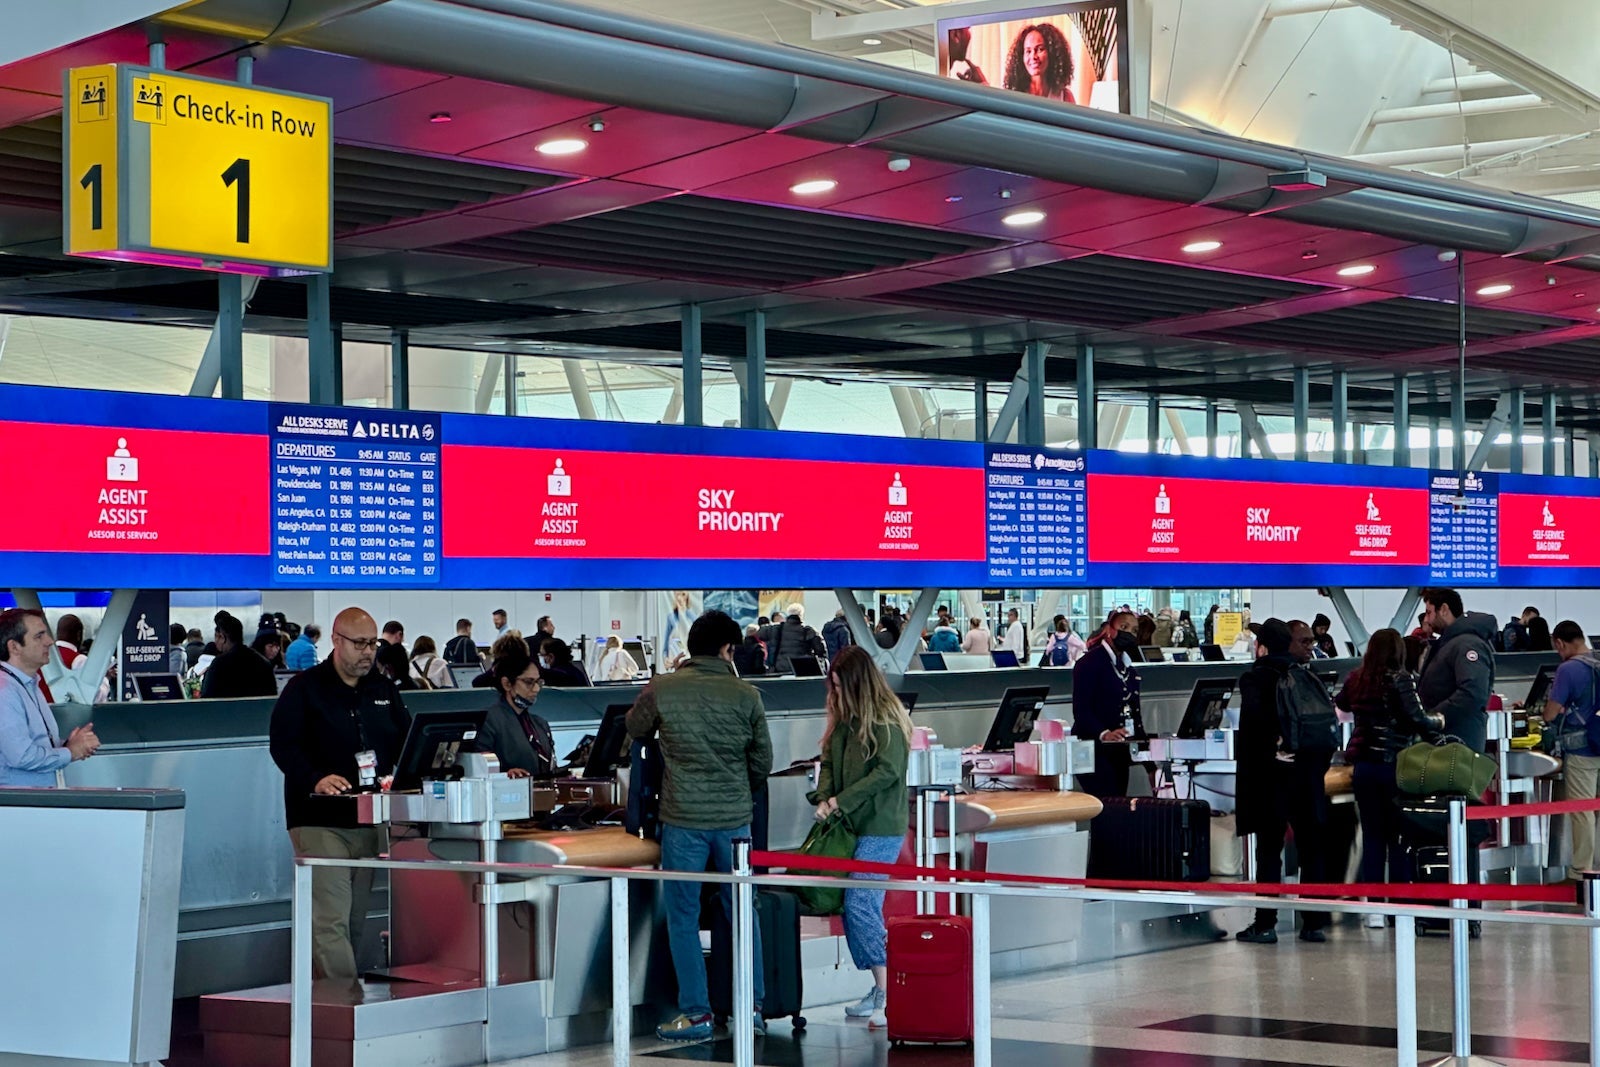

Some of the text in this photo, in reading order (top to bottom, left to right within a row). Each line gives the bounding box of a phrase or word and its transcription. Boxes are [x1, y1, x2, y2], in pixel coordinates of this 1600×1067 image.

[173, 94, 315, 138] Check-in Row
[80, 164, 102, 230] 1
[221, 158, 250, 244] 1
[283, 416, 348, 429] ALL DESKS SERVE
[369, 422, 419, 439] DELTA
[276, 443, 436, 462] DEPARTURES 9:45 AM STATUS GATE
[277, 464, 288, 473] Las
[289, 465, 309, 476] Vegas,
[310, 466, 321, 474] NV
[330, 466, 338, 475] DL
[374, 469, 384, 477] AM
[388, 469, 414, 479] On-Time
[277, 479, 321, 489] Providenciales
[330, 481, 339, 490] DL
[388, 483, 395, 492] At
[396, 483, 410, 492] Gate
[98, 488, 148, 505] AGENT
[278, 493, 290, 502] San
[291, 494, 306, 502] Juan
[330, 495, 339, 504] DL
[388, 497, 415, 506] On-Time
[698, 488, 735, 509] SKY
[278, 508, 289, 517] Los
[316, 509, 325, 517] CA
[330, 509, 339, 518] DL
[375, 510, 385, 519] PM
[388, 511, 397, 519] At
[398, 511, 411, 520] Gate
[541, 502, 578, 516] AGENT
[1247, 507, 1270, 524] SKY
[98, 508, 148, 525] ASSIST
[698, 511, 781, 531] PRIORITY
[884, 511, 913, 523] AGENT
[278, 522, 326, 532] Raleigh-Durham
[330, 523, 339, 532] DL
[375, 524, 385, 533] PM
[388, 525, 415, 534] On-Time
[542, 519, 578, 533] ASSIST
[1152, 518, 1174, 530] AGENT
[88, 530, 158, 540] ASESOR DE SERVICIO
[884, 526, 913, 538] ASSIST
[1152, 532, 1174, 543] ASSIST
[1247, 525, 1300, 542] PRIORITY
[278, 536, 299, 546] Ithaca,
[300, 537, 310, 545] NY
[330, 538, 339, 546] DL
[388, 539, 415, 548] On-Time
[278, 551, 292, 560] West
[293, 551, 308, 560] Palm
[308, 551, 326, 560] Beach
[330, 552, 339, 561] DL
[375, 552, 385, 561] PM
[389, 553, 396, 561] At
[397, 552, 411, 561] Gate
[278, 565, 306, 576] Orlando,
[307, 566, 314, 575] FL
[330, 566, 340, 575] DL
[376, 567, 386, 575] PM
[389, 566, 416, 576] On-Time
[126, 646, 165, 654] SELF-SERVICE
